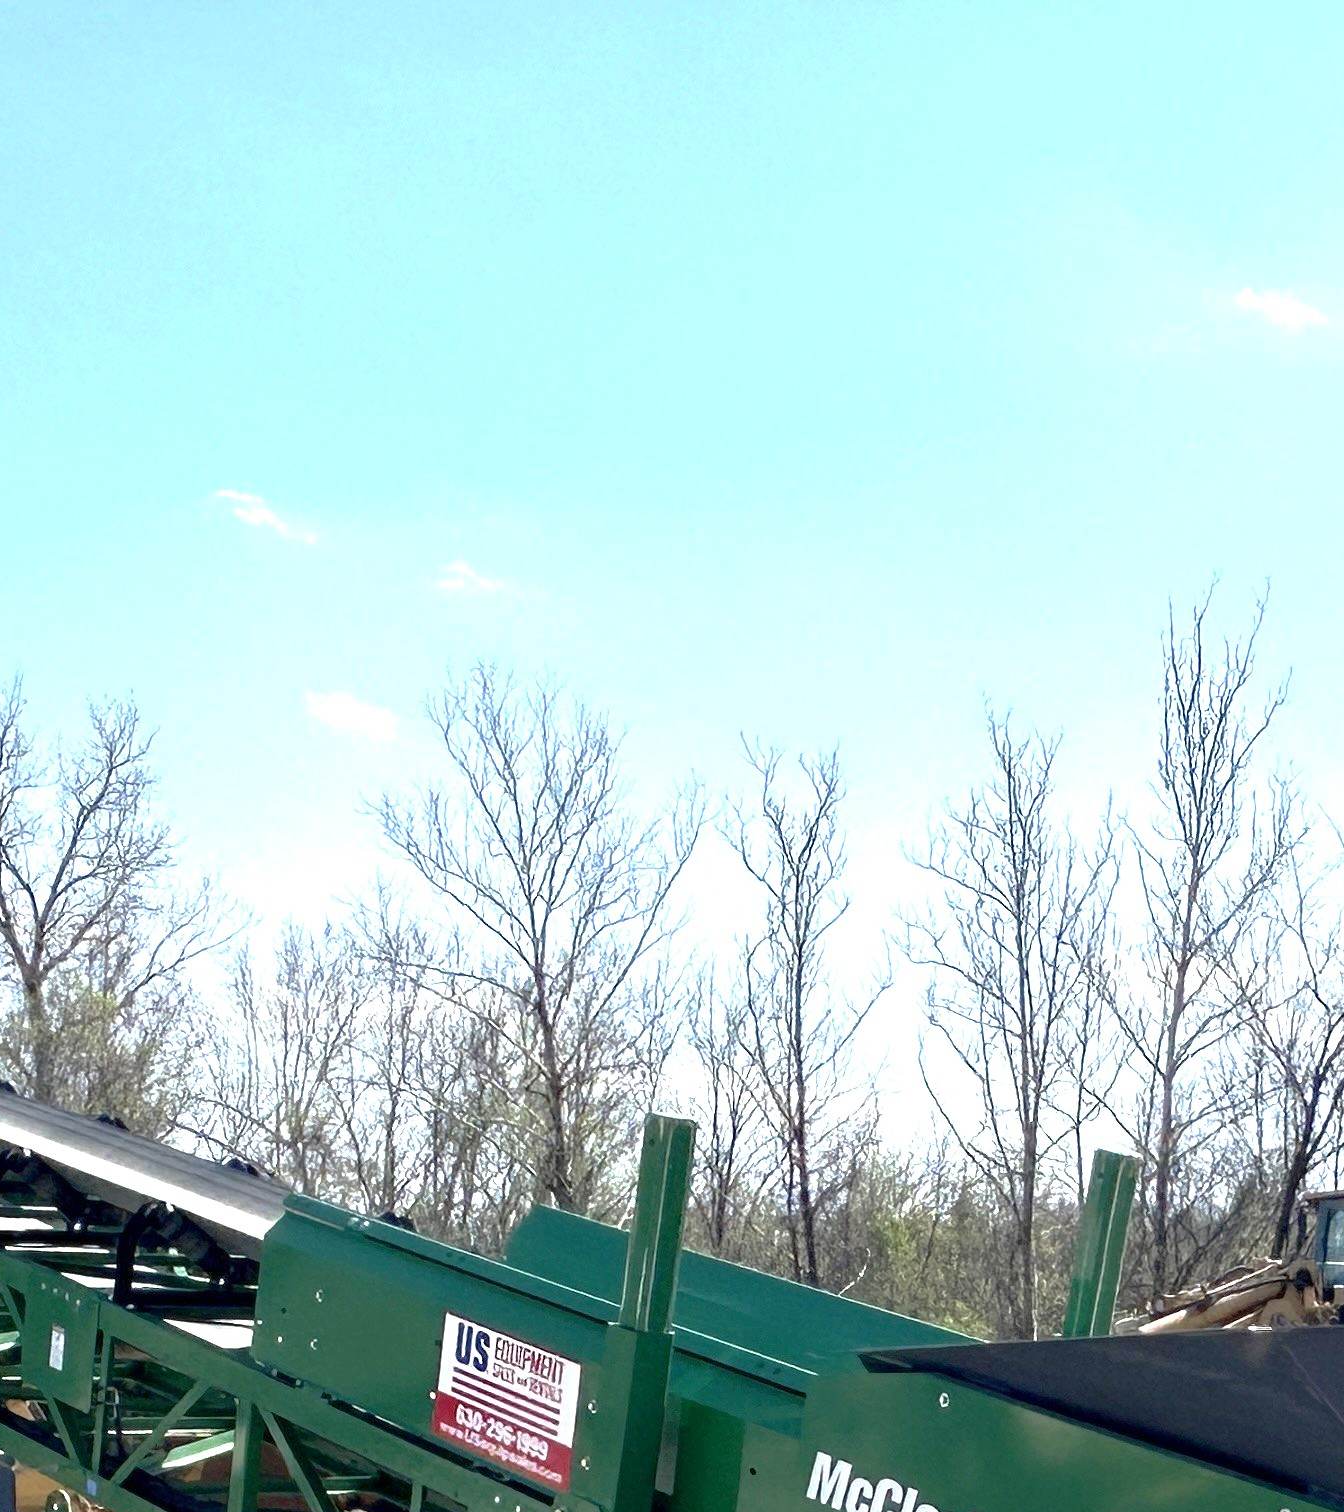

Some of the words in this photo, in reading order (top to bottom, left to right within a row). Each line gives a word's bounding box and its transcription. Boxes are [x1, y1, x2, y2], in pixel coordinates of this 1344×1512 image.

[455, 1322, 490, 1372] US
[494, 1337, 566, 1385] EQUIPMENT
[456, 1403, 549, 1461] 630-296-1999
